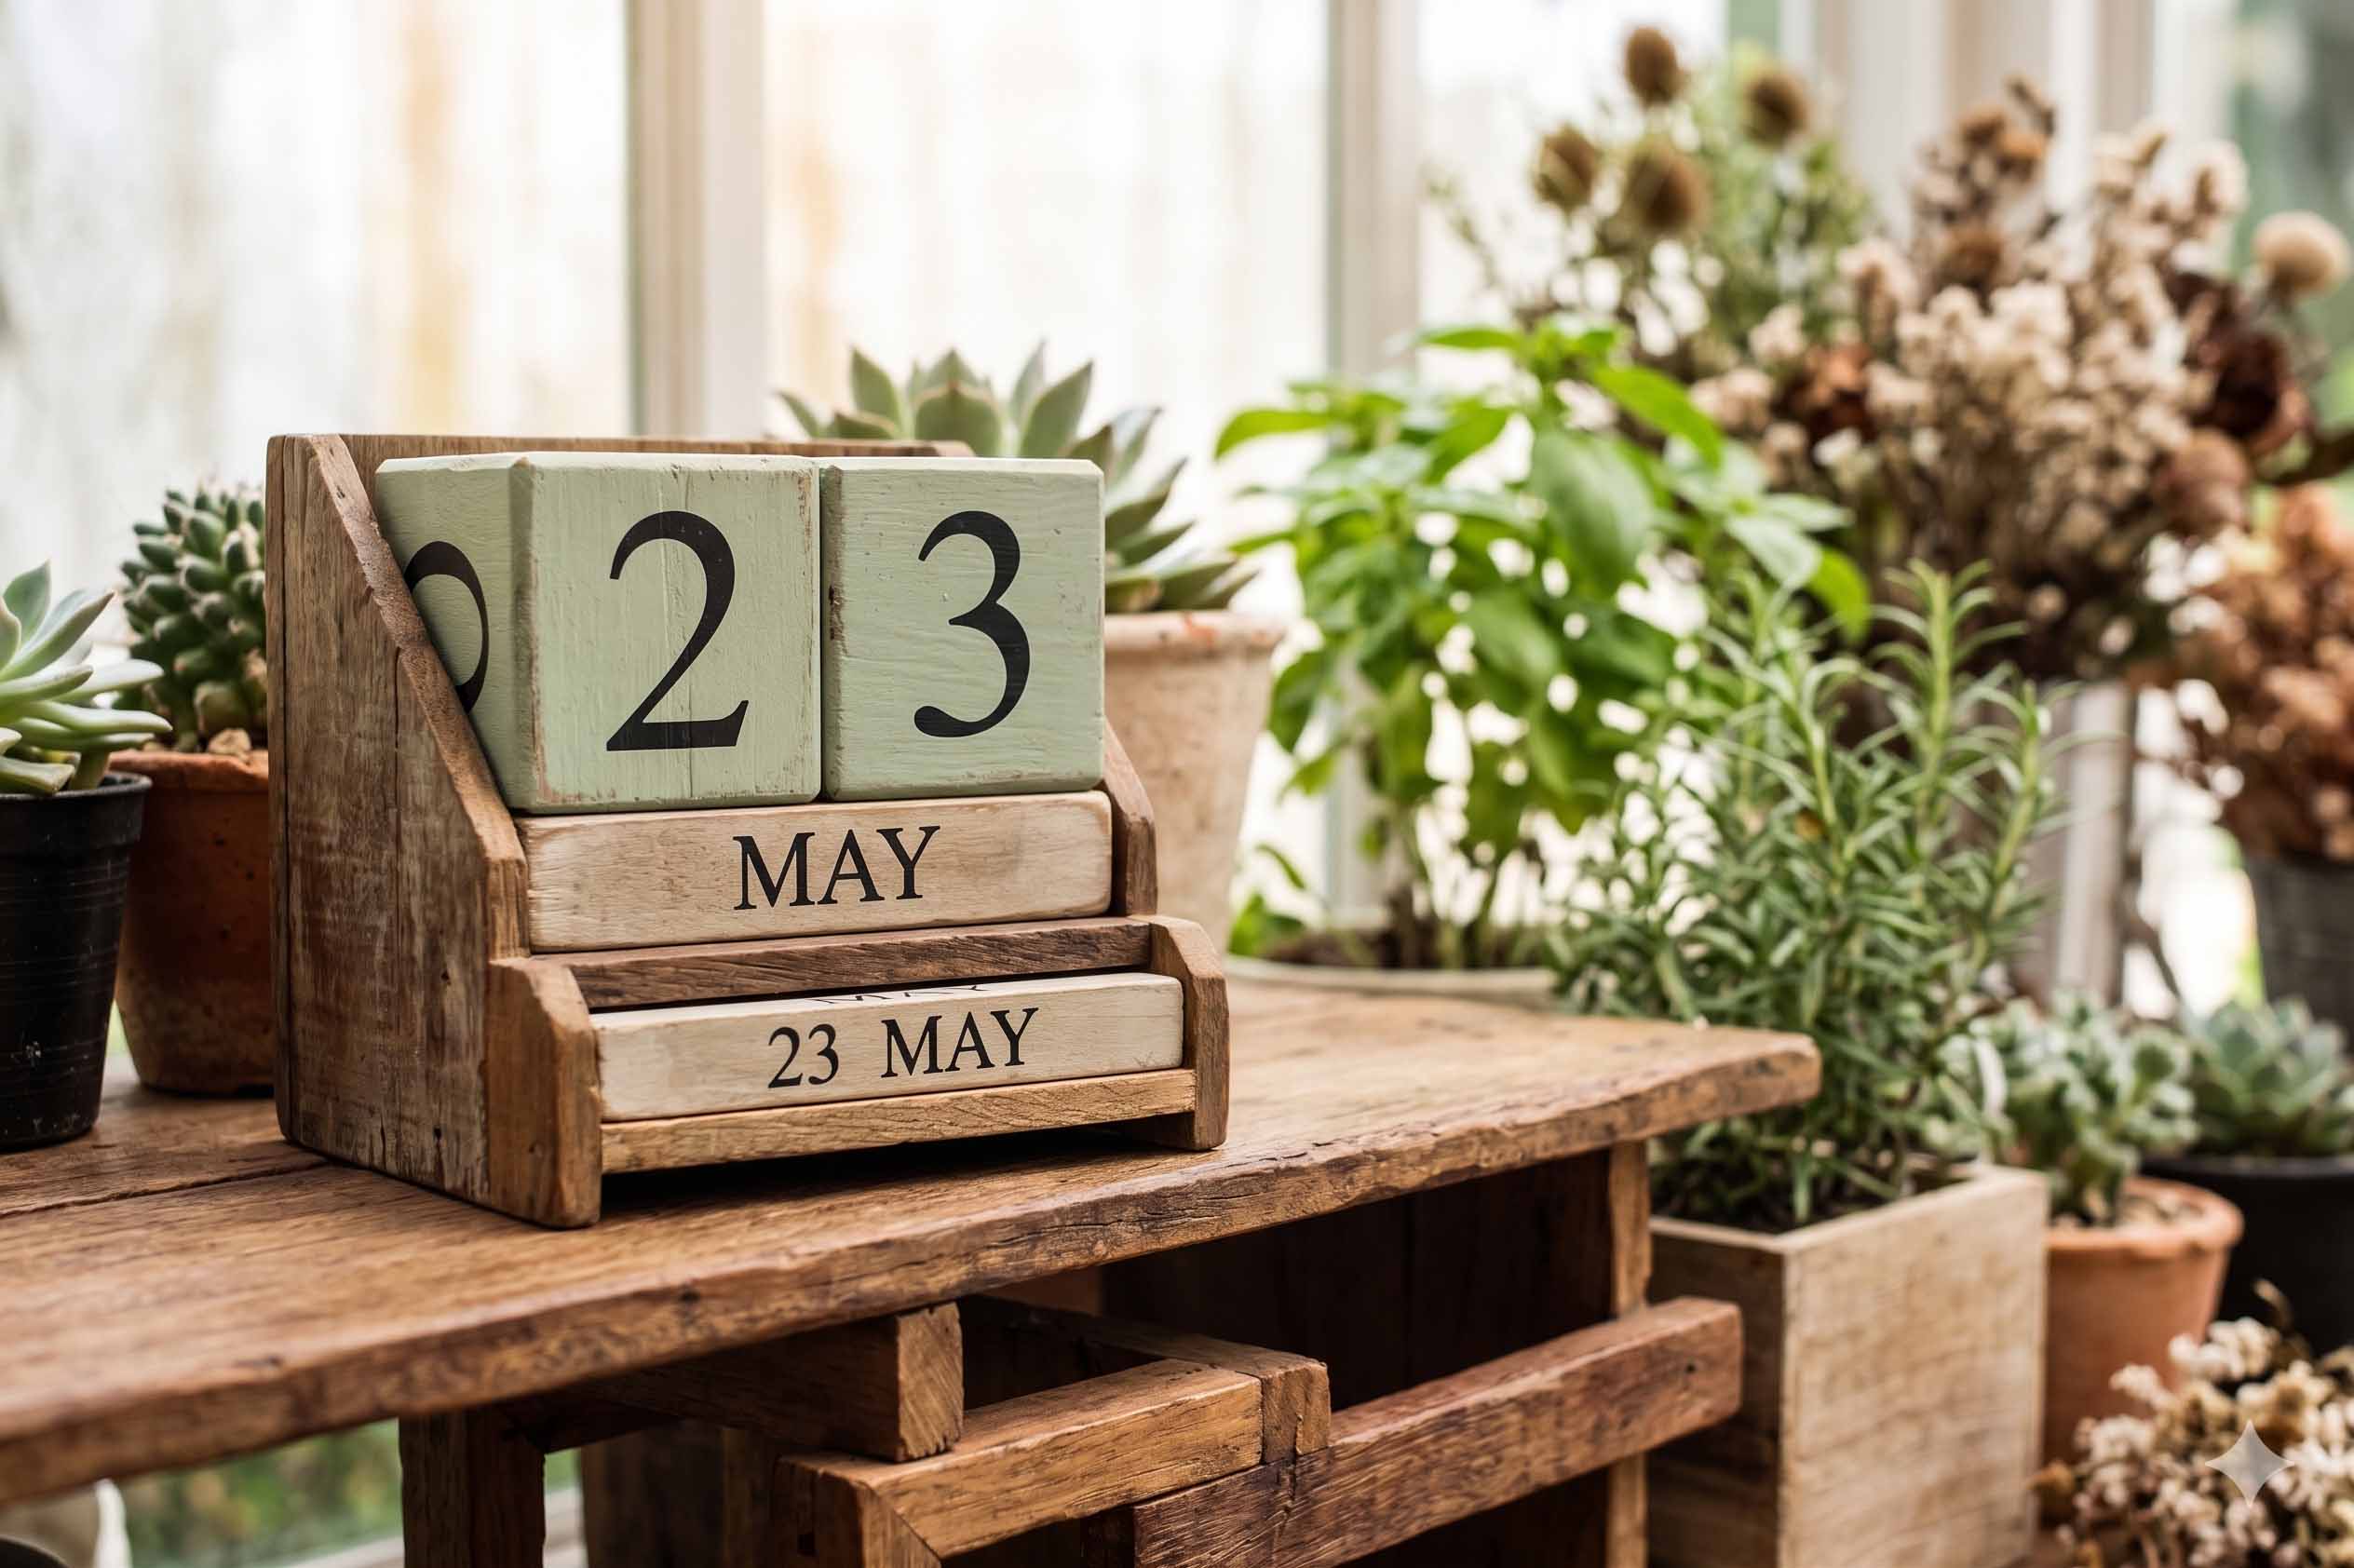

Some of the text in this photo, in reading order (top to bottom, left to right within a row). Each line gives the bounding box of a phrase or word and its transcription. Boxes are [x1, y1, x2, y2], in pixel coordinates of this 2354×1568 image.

[733, 824, 942, 911] MAY
[766, 1007, 1039, 1089] 23 MAY
